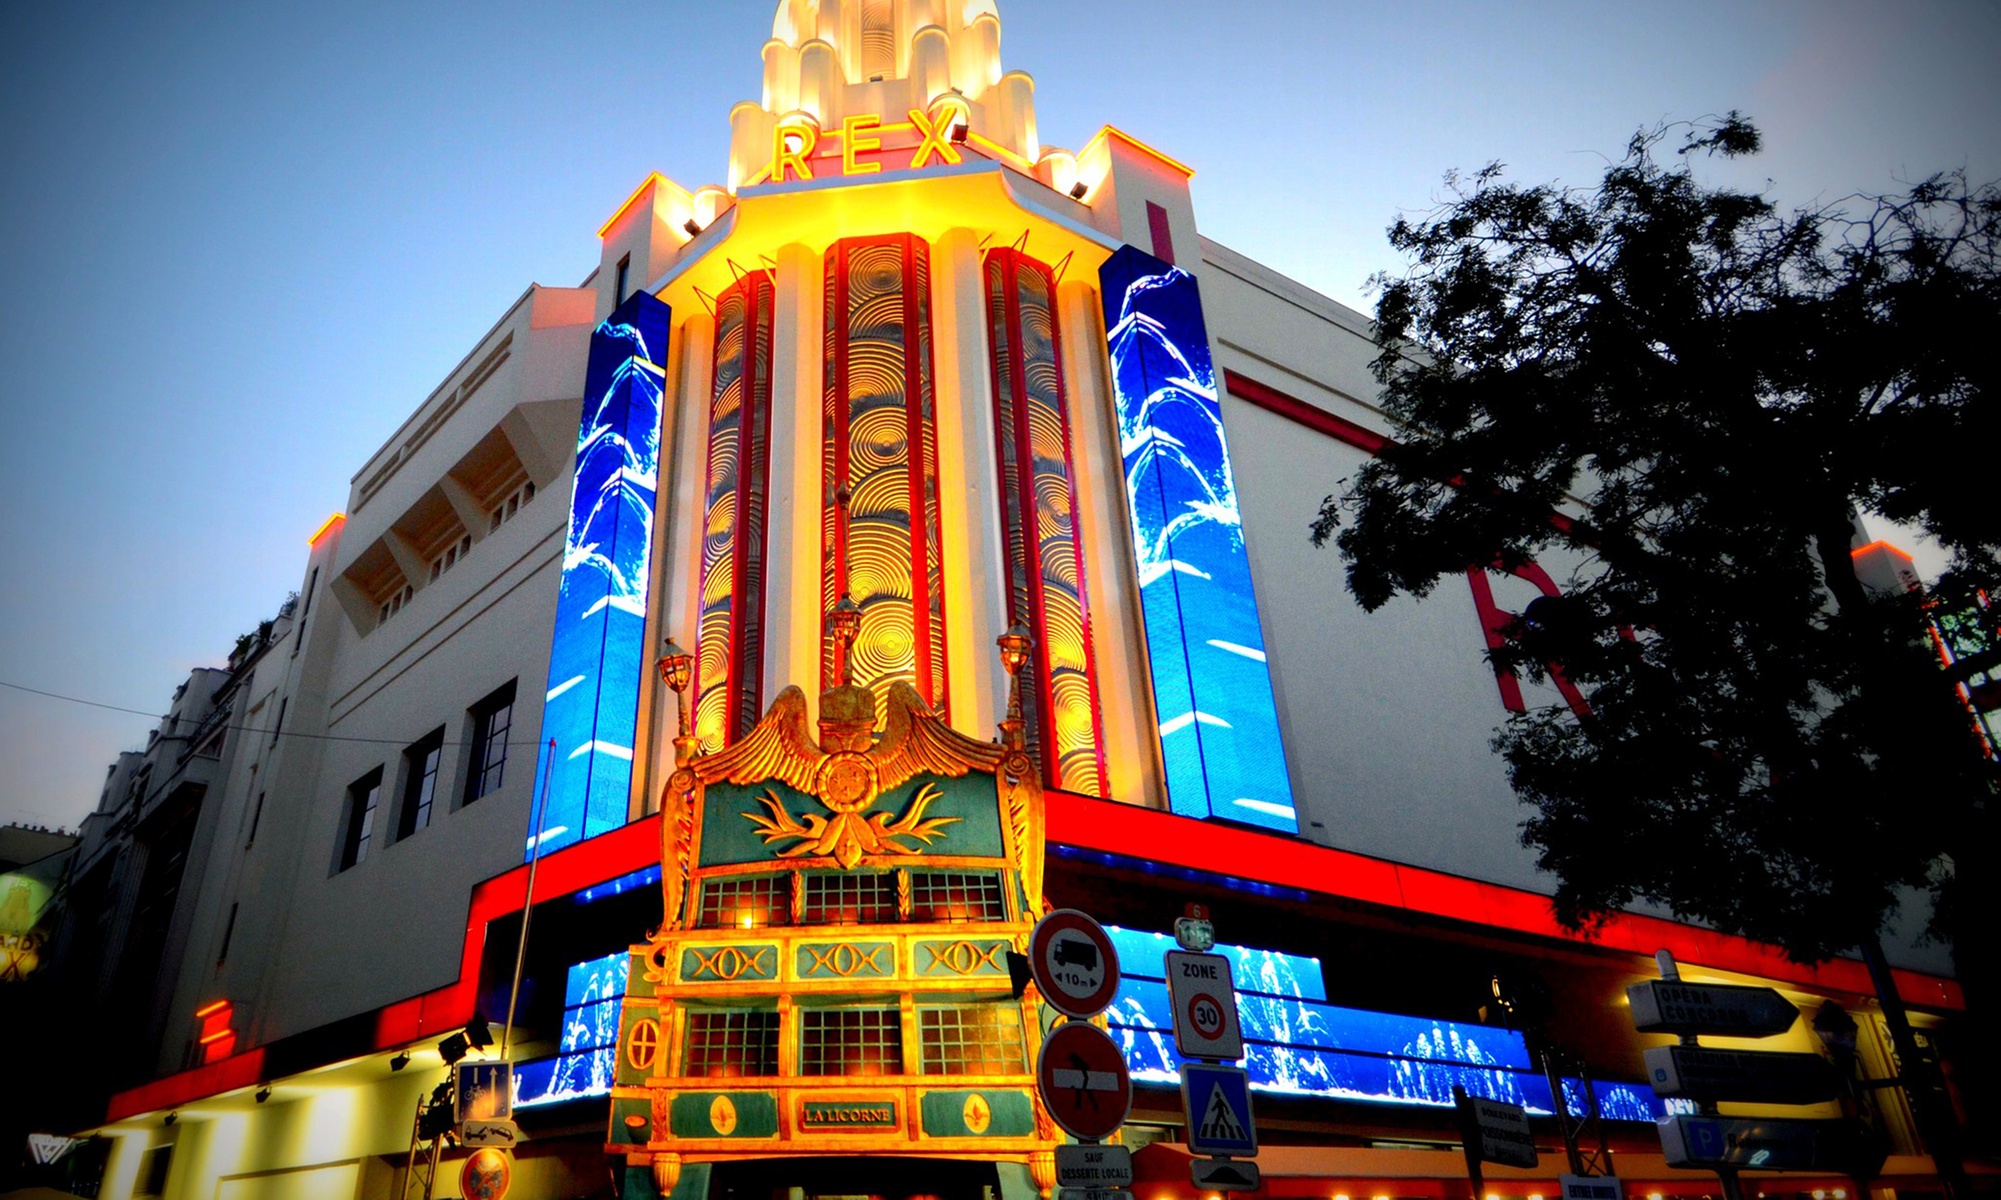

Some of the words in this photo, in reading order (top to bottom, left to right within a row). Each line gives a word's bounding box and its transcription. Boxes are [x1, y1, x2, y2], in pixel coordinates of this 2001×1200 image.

[771, 106, 963, 182] REX
[1182, 963, 1218, 980] ZONE
[1661, 987, 1712, 1004] OPÉRA
[1196, 1006, 1218, 1026] 30
[802, 1108, 824, 1122] LA
[825, 1107, 891, 1122] LICORNE
[1084, 1152, 1104, 1164] SAUF
[1061, 1168, 1099, 1180] DESSERTE
[1101, 1168, 1129, 1180] LOCALE
